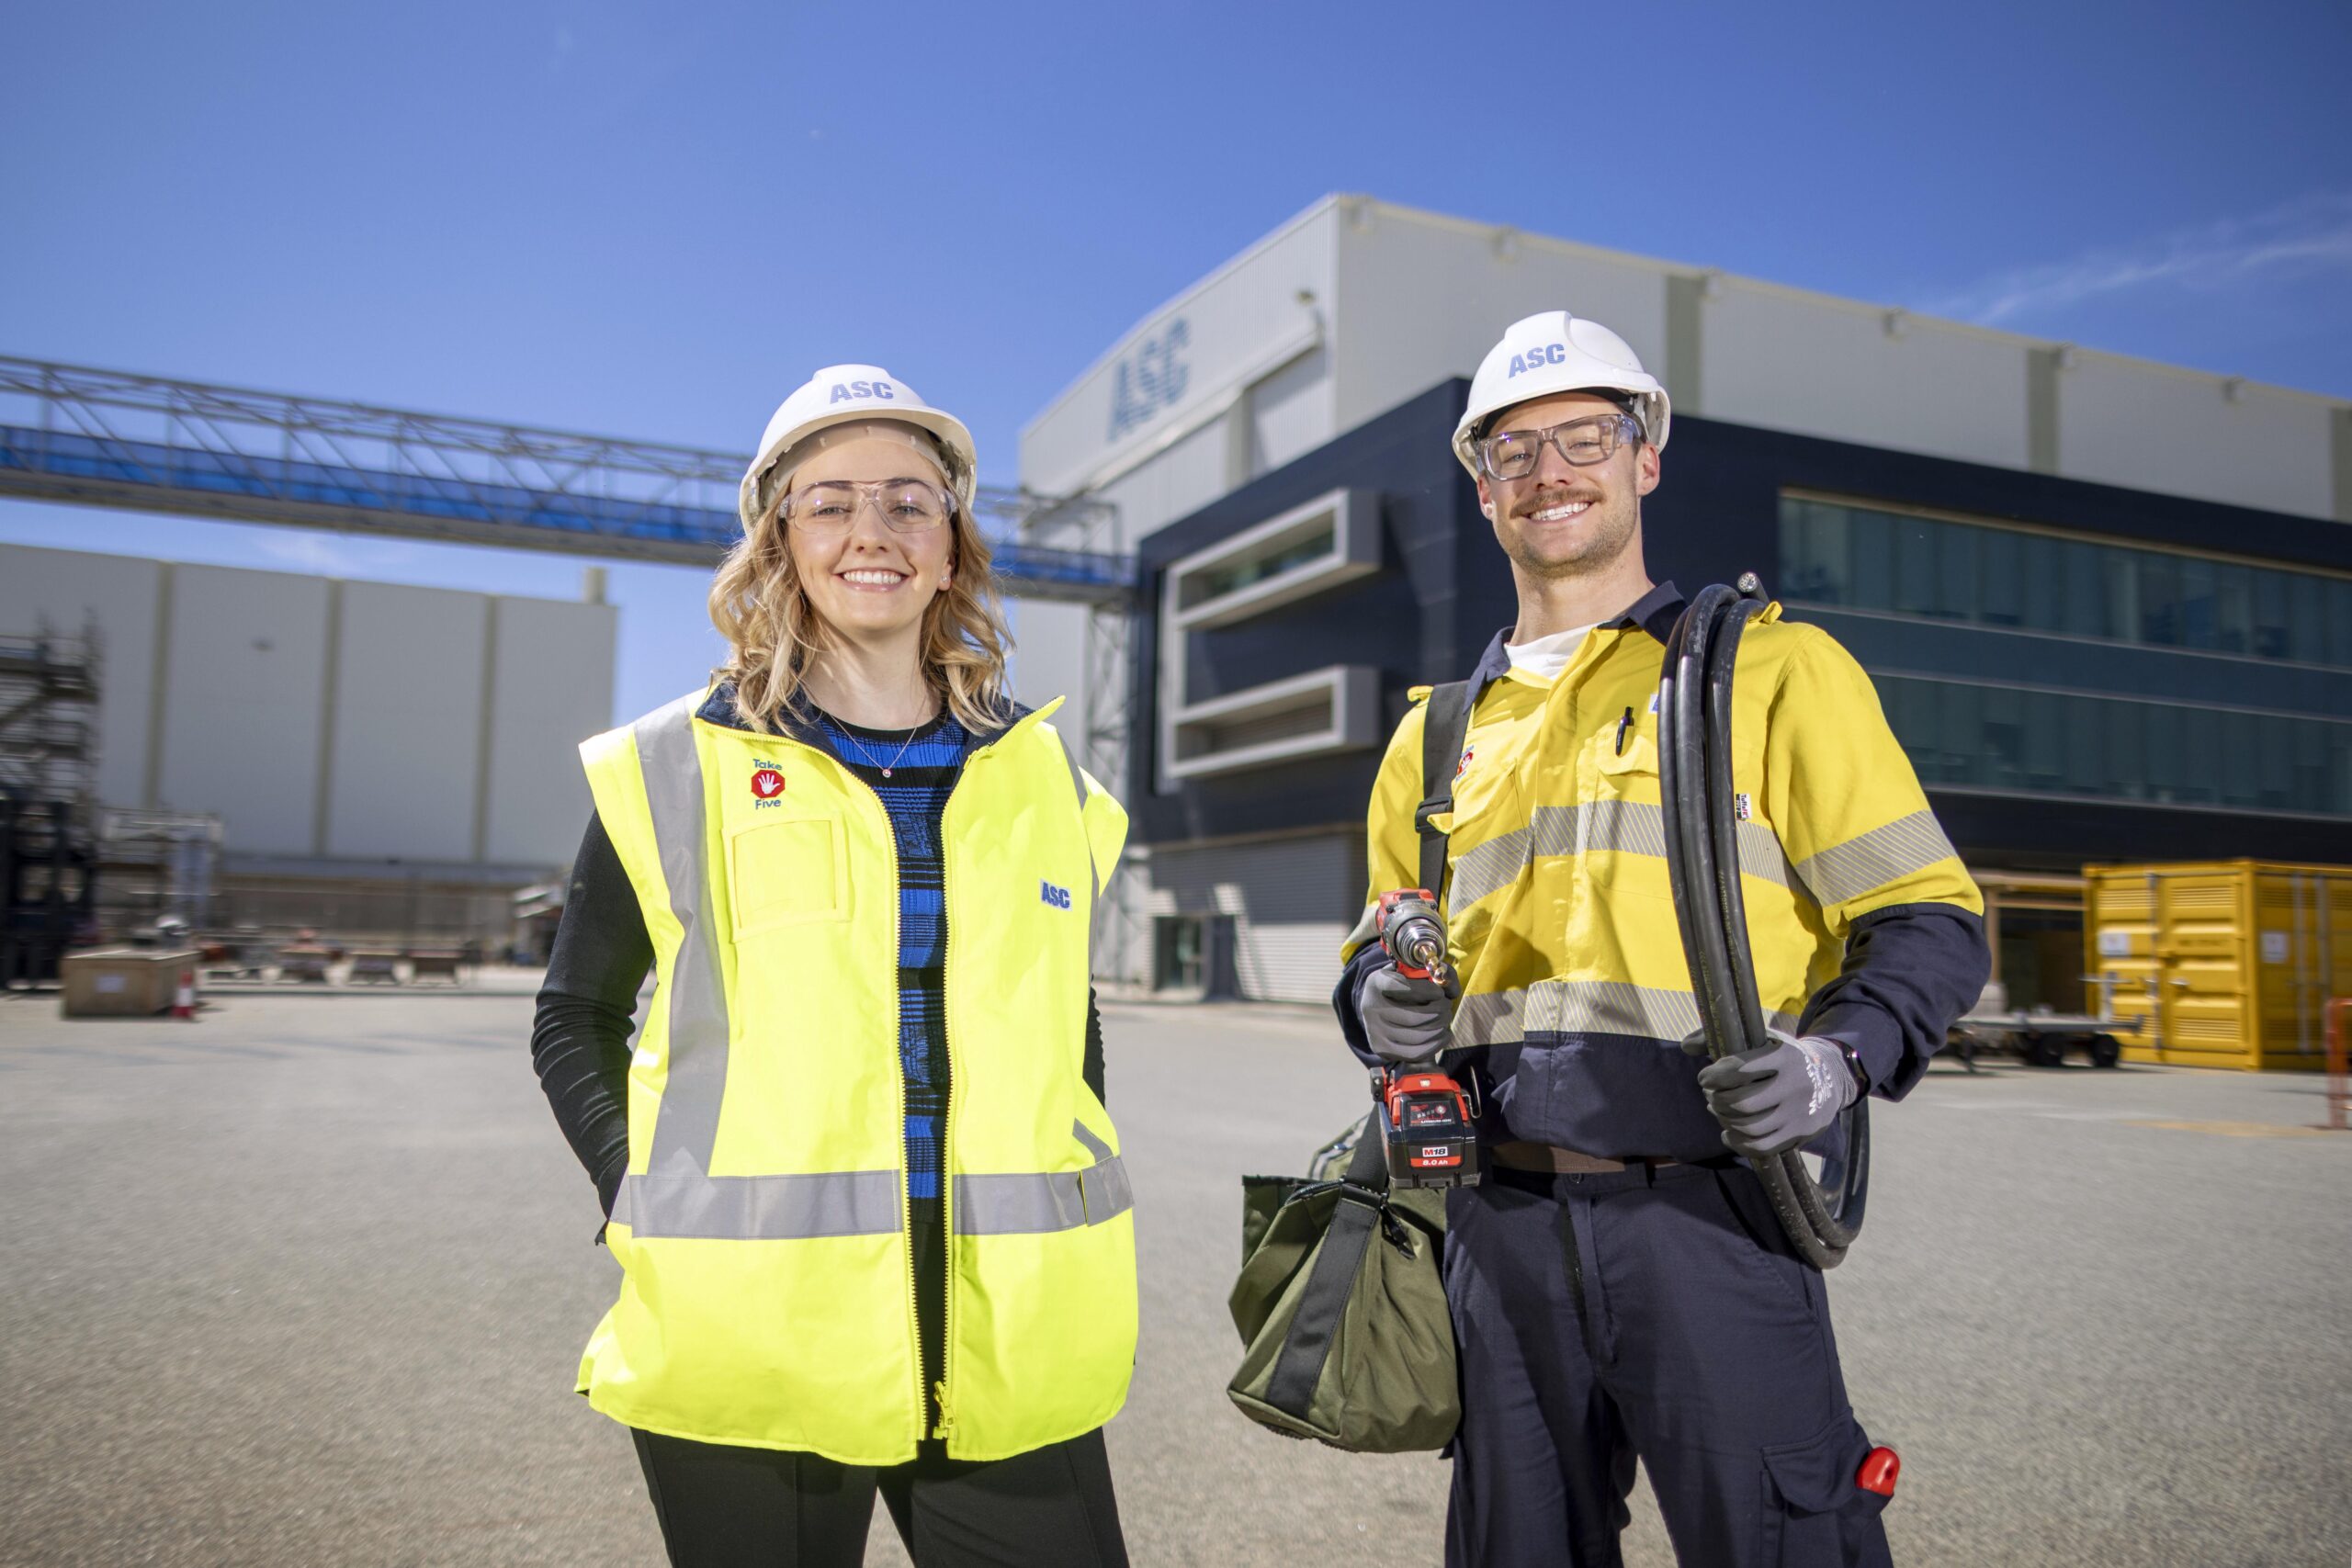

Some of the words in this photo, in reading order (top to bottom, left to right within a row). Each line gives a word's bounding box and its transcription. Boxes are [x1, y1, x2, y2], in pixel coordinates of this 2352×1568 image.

[1508, 344, 1566, 378] ASC
[830, 380, 894, 404] ASC
[752, 758, 783, 770] Take
[755, 799, 781, 809] Five
[1041, 882, 1069, 908] ASC
